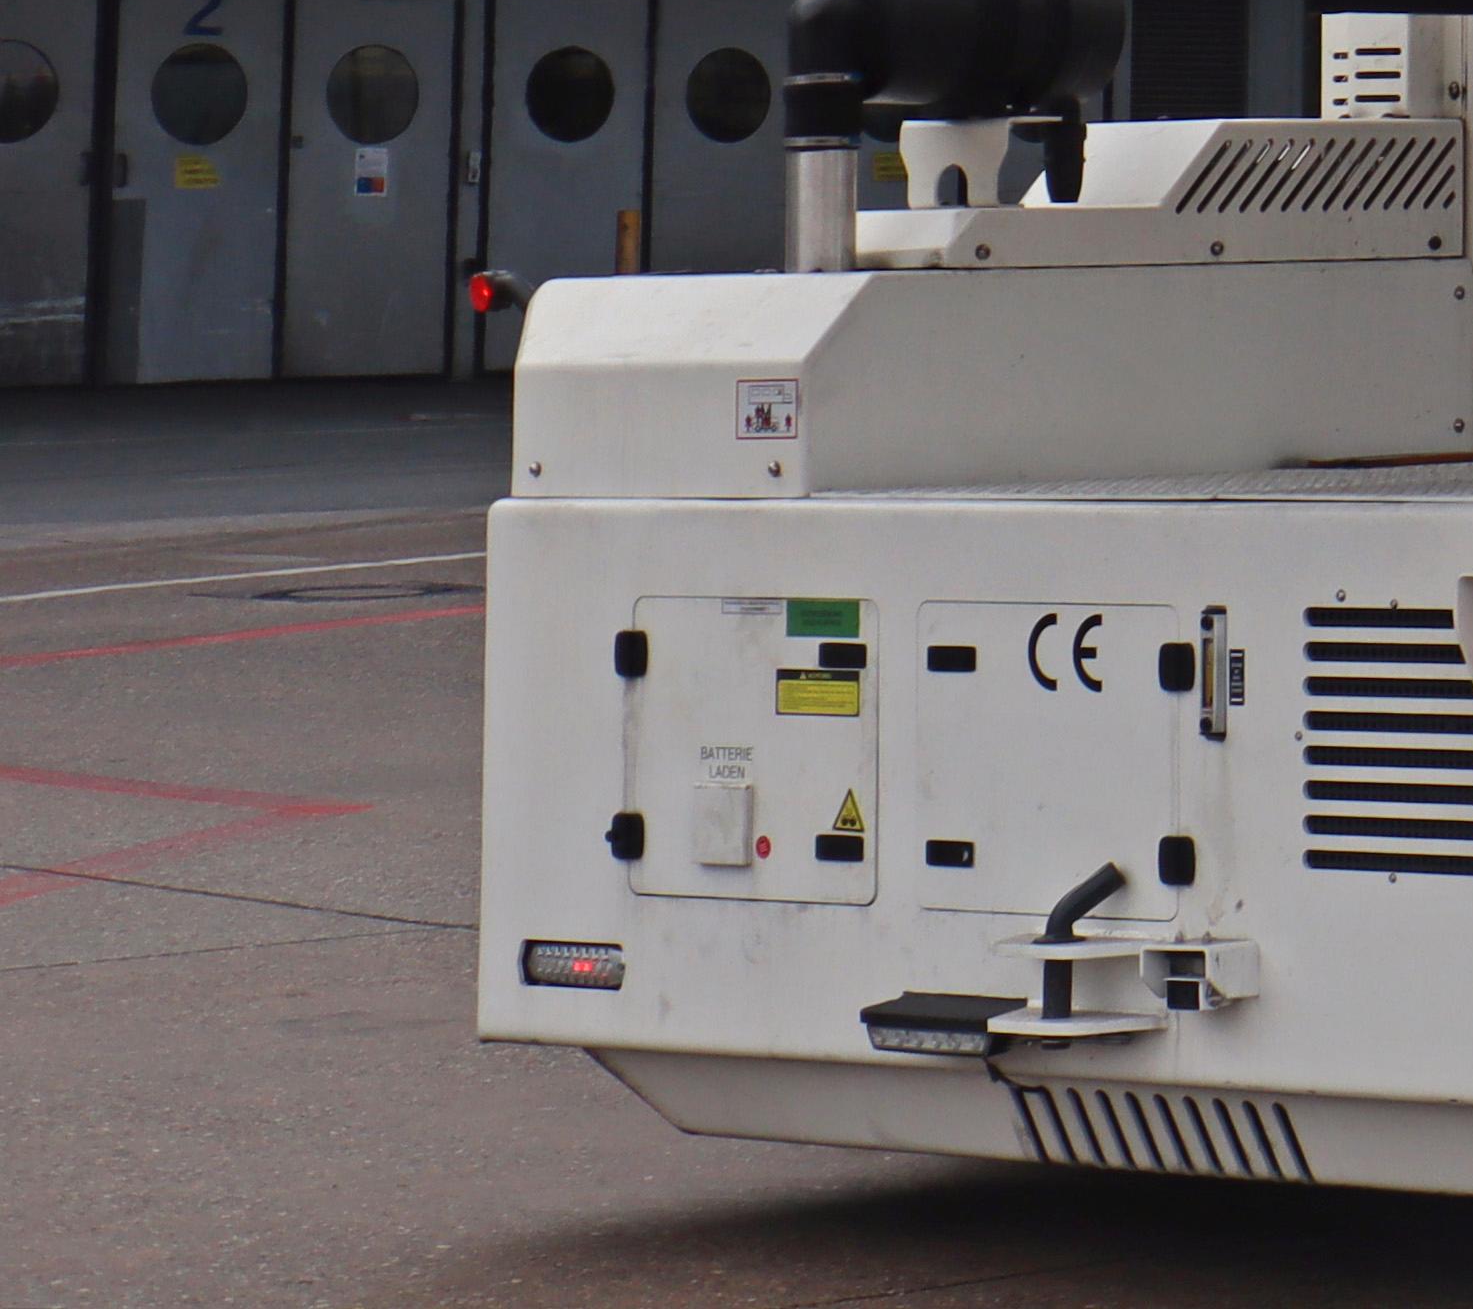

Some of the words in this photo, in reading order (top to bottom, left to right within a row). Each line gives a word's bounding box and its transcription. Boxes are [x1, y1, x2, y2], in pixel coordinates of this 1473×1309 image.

[1027, 612, 1103, 693] CE
[700, 746, 754, 762] BATTERIE
[708, 764, 746, 780] LADEN
